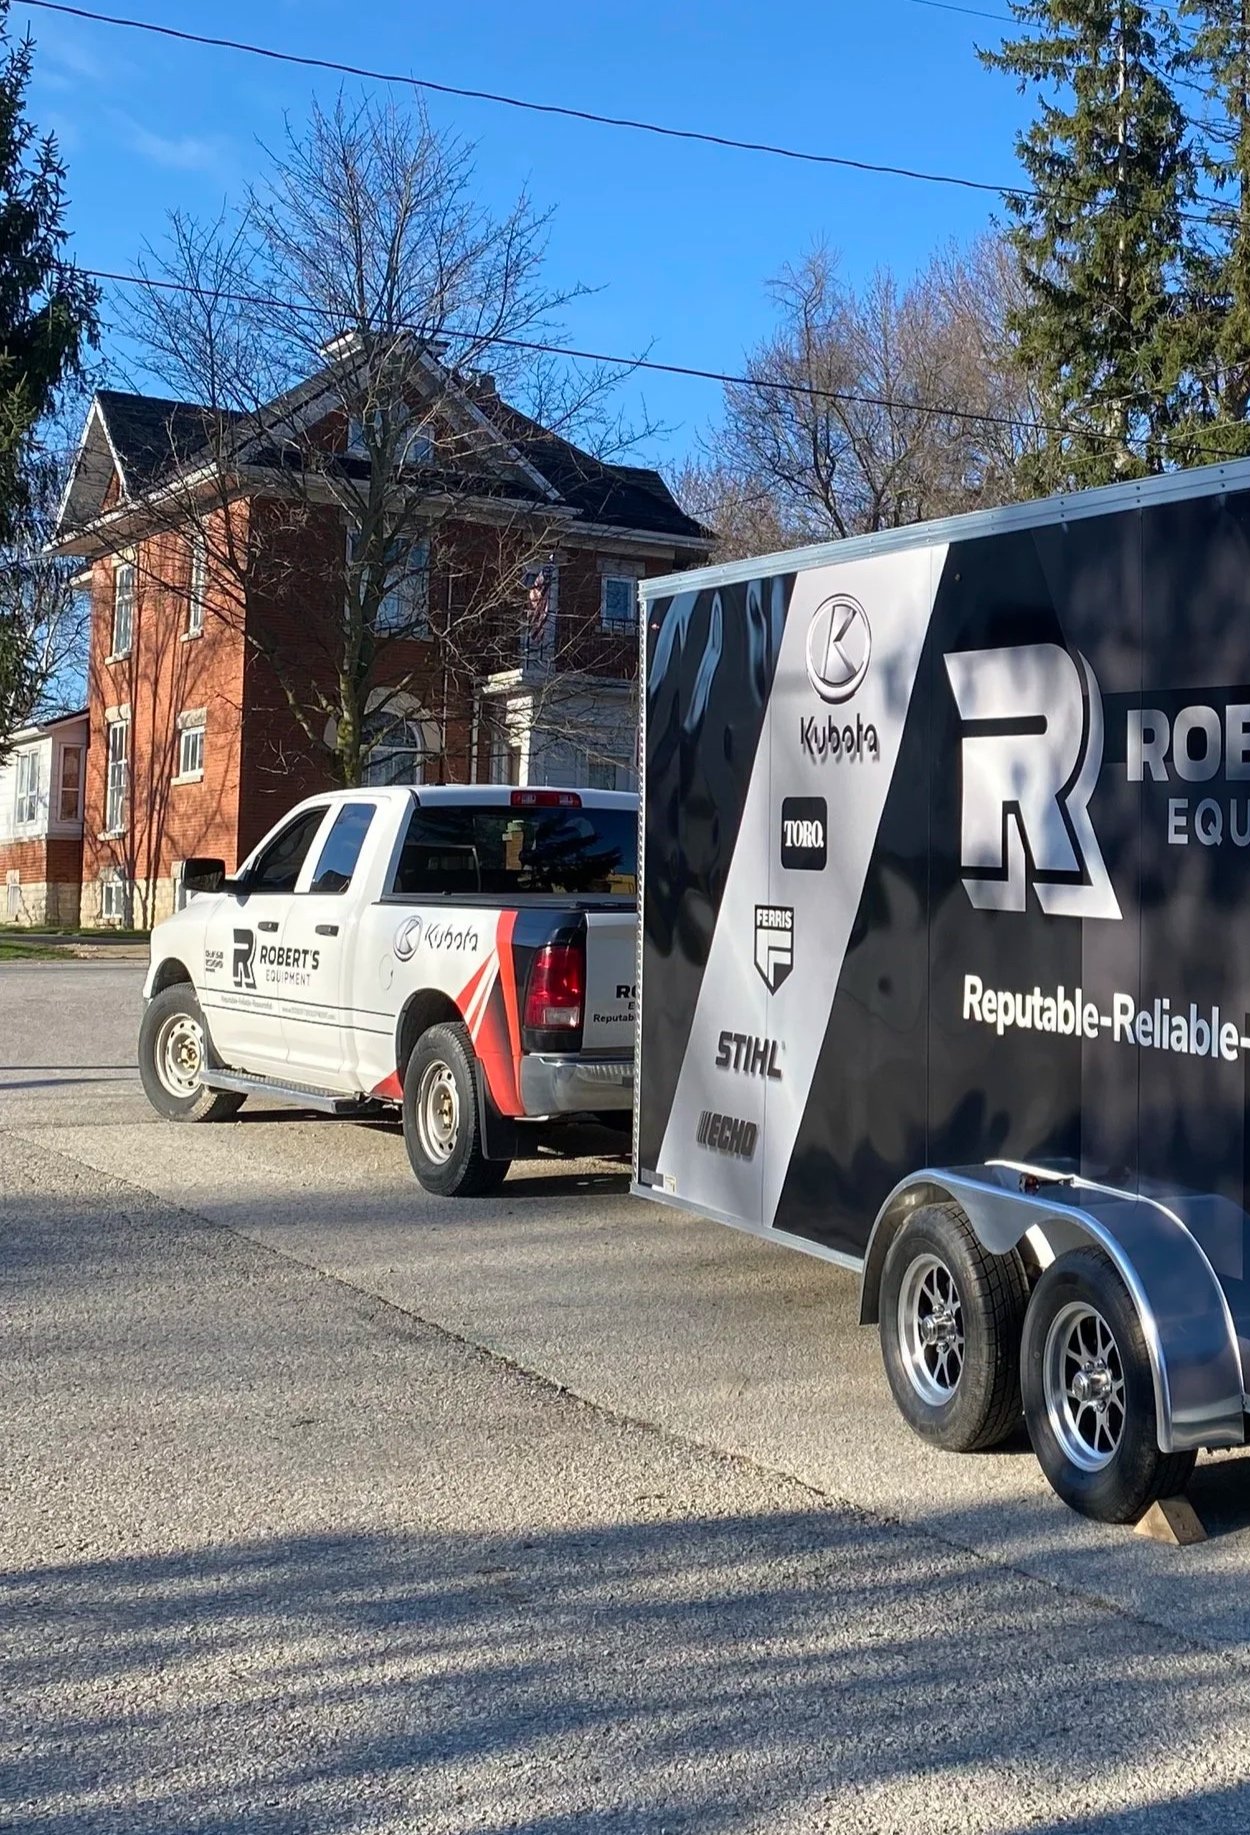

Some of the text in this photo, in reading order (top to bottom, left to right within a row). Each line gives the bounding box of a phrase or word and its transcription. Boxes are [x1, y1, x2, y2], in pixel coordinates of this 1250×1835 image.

[800, 712, 879, 760] Kubota
[783, 820, 824, 848] TORO
[756, 908, 793, 929] FERRIS
[424, 923, 479, 952] Kubota
[259, 945, 320, 970] ROBERT'S
[265, 968, 311, 987] EQUIPMENT
[715, 1030, 782, 1079] STIHL
